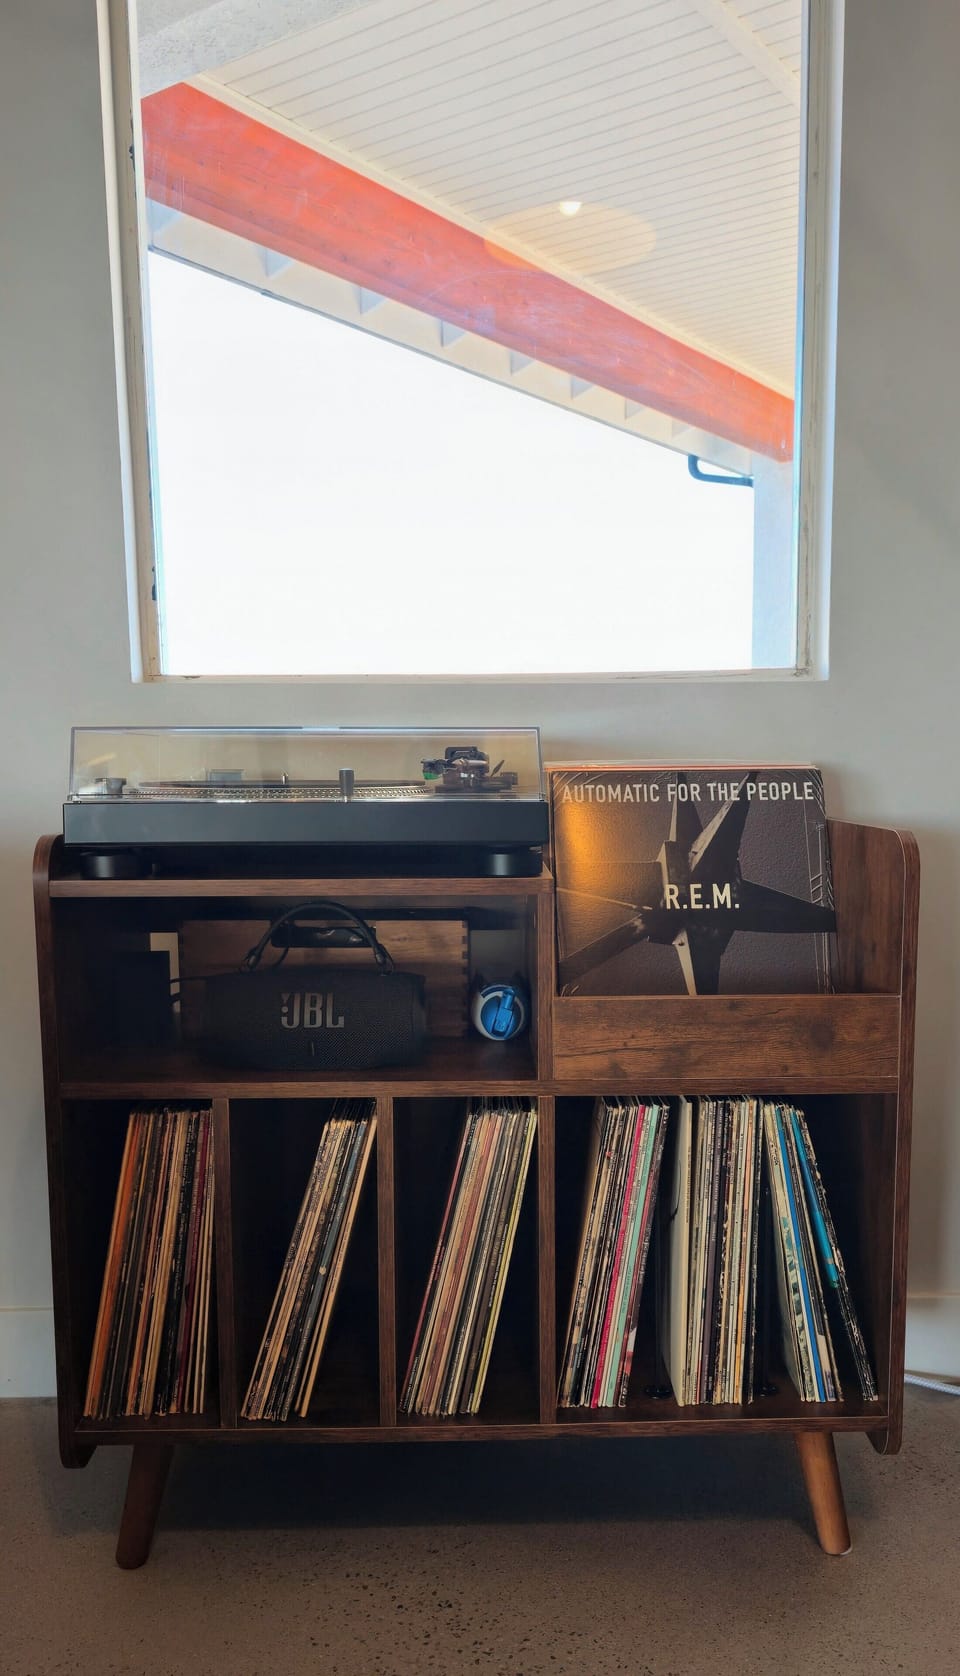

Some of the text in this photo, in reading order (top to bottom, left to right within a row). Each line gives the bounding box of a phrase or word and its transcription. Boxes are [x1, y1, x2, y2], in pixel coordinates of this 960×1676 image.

[562, 781, 815, 803] AUTOMATIC FOR THE PEOPLE
[665, 883, 740, 910] R.E.M.
[281, 992, 345, 1028] JBL
